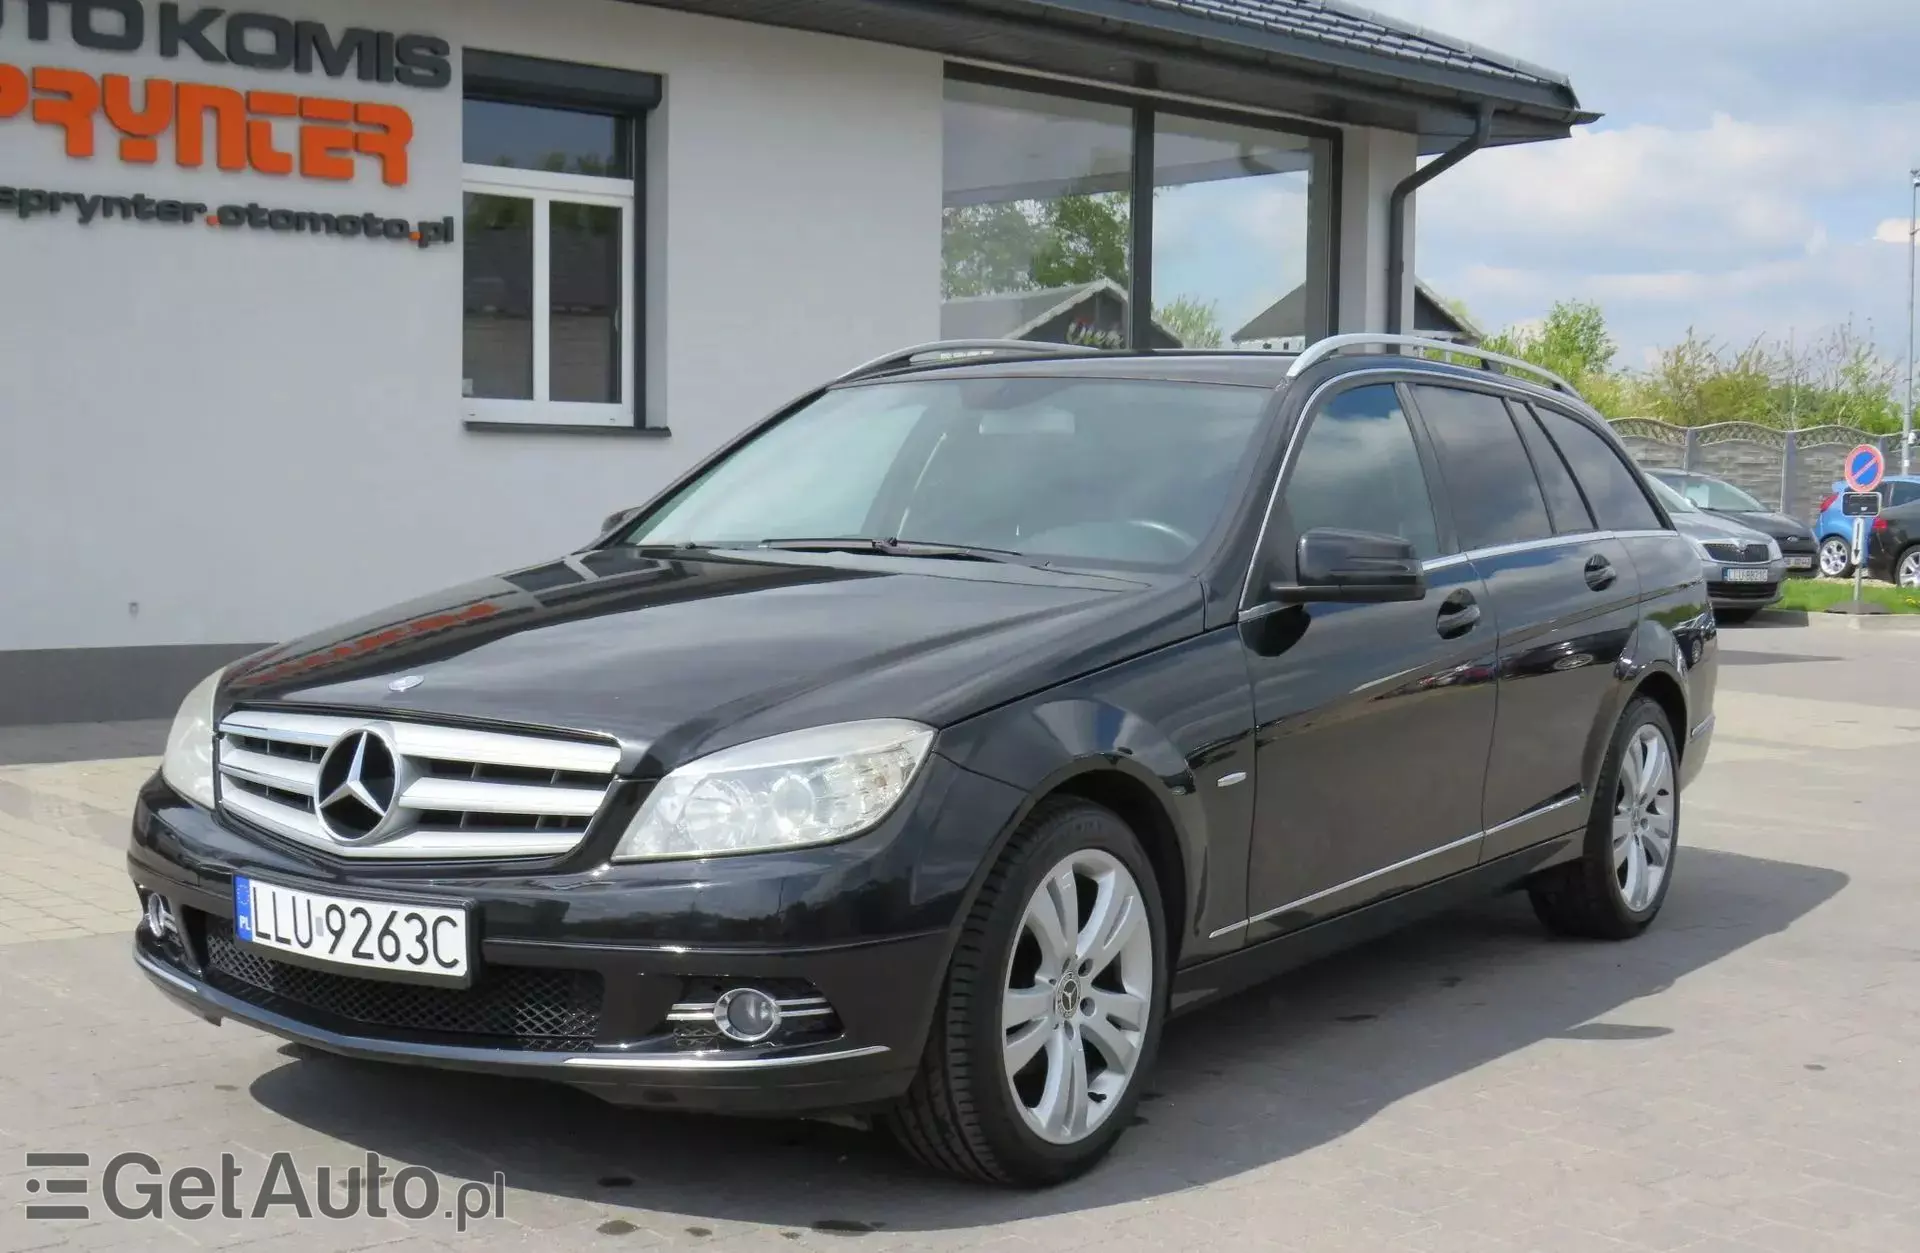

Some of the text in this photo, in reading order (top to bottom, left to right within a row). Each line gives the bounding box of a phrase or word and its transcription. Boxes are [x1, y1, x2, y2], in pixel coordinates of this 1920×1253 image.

[0, 0, 453, 89] TO KOMIS
[0, 186, 455, 249] sprynter.otomoto.pl
[252, 886, 460, 969] LLU 9263C
